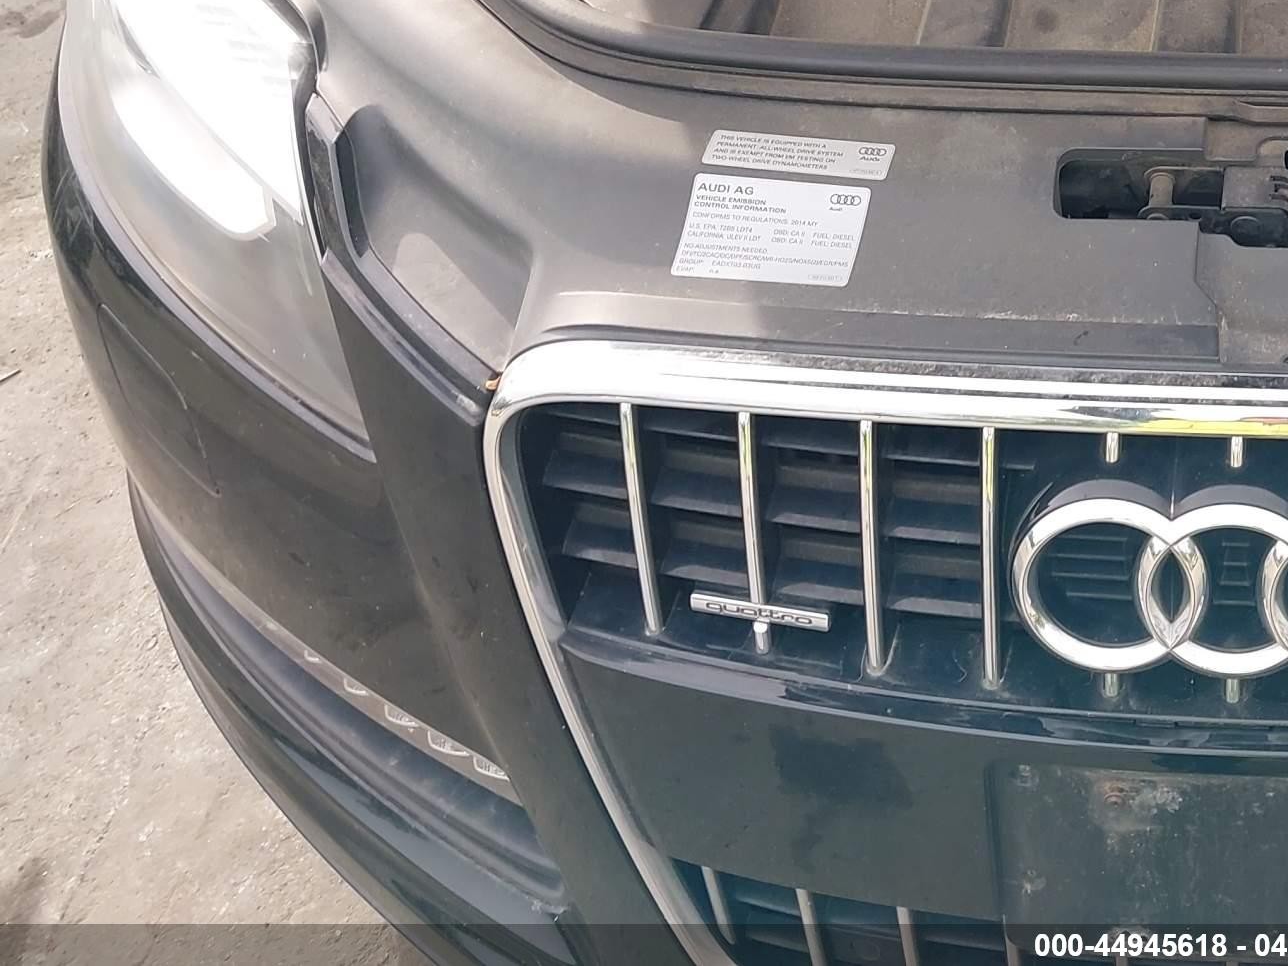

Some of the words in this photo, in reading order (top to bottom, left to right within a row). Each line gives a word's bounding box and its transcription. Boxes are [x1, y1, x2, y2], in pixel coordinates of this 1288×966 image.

[736, 135, 762, 143] VEHICLE
[770, 139, 802, 147] EQUIPPED
[772, 159, 828, 170] DYNAMOMETERS
[698, 182, 730, 194] AUDI
[733, 185, 754, 196] AG
[696, 194, 726, 202] VEHICLE
[728, 197, 767, 206] EMISSION
[694, 201, 730, 210] CONTROL
[731, 204, 787, 214] INFORMATION
[832, 233, 855, 242] DIESEL
[830, 241, 853, 249] DIESEL
[706, 601, 813, 625] quattro
